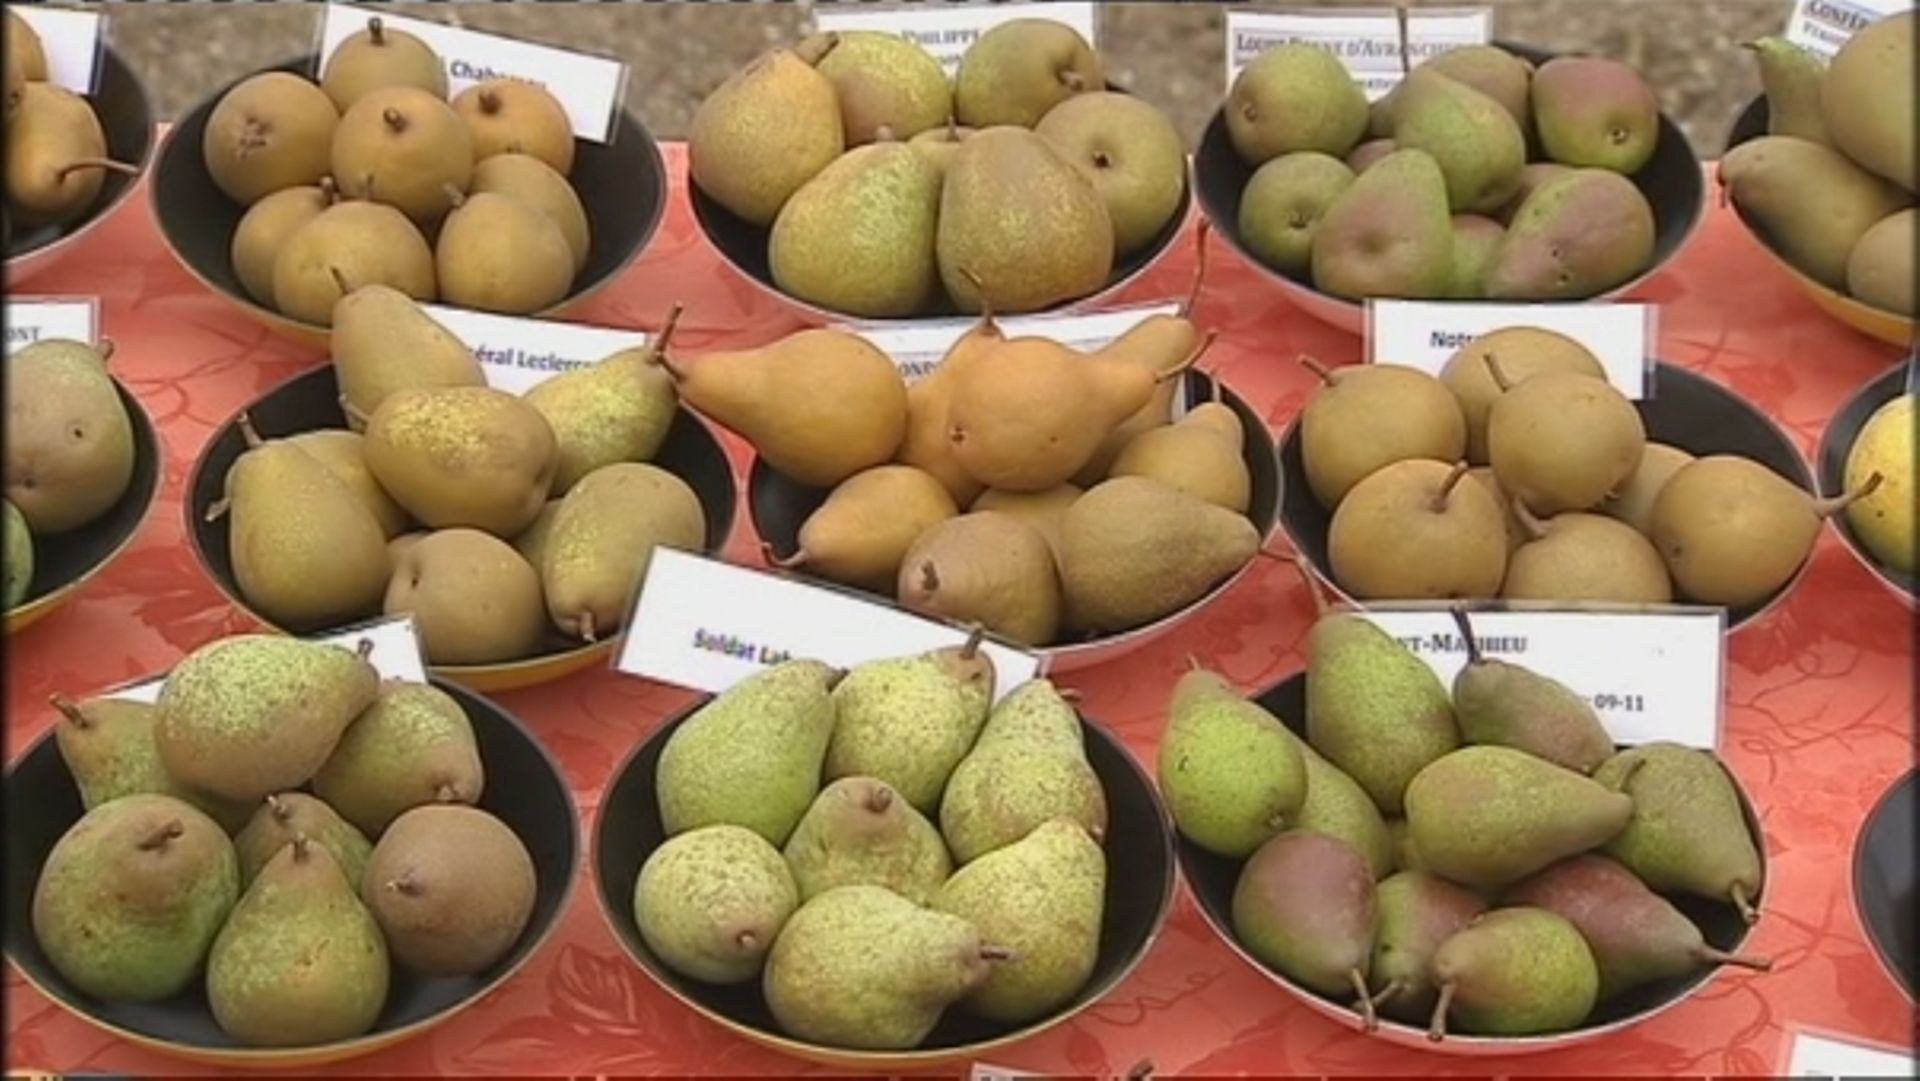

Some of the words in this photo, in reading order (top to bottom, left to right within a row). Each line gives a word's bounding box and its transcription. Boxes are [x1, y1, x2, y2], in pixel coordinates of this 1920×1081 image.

[1429, 330, 1487, 349] Notr
[467, 344, 514, 365] éral
[693, 627, 756, 661] Soldat
[1594, 693, 1644, 712] 09-11
